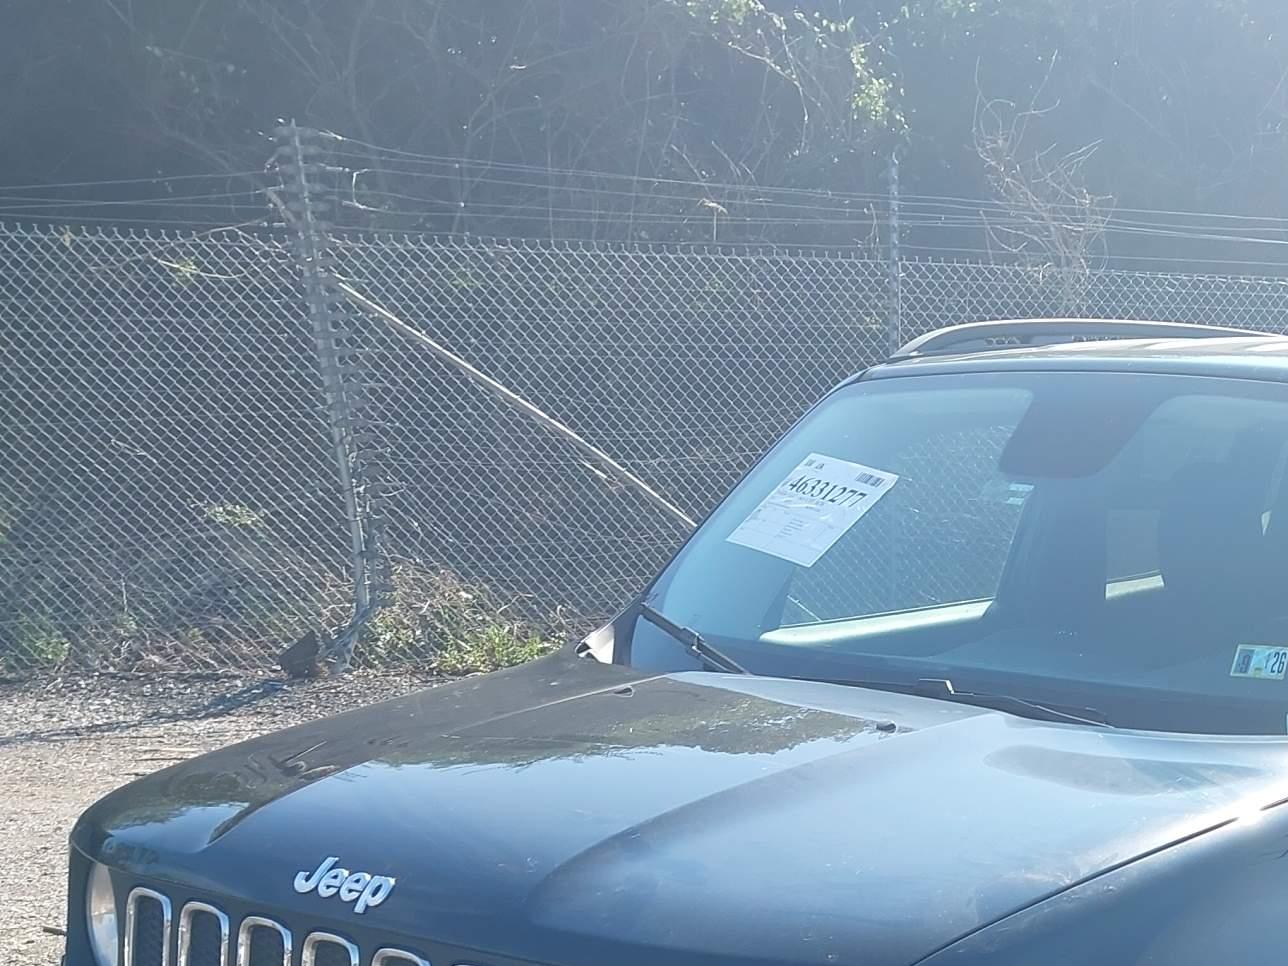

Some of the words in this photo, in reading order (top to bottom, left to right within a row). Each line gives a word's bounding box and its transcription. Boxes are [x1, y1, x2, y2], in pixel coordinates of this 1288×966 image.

[789, 475, 868, 508] 46331277
[1270, 651, 1287, 674] 26
[293, 856, 396, 914] Jeep
